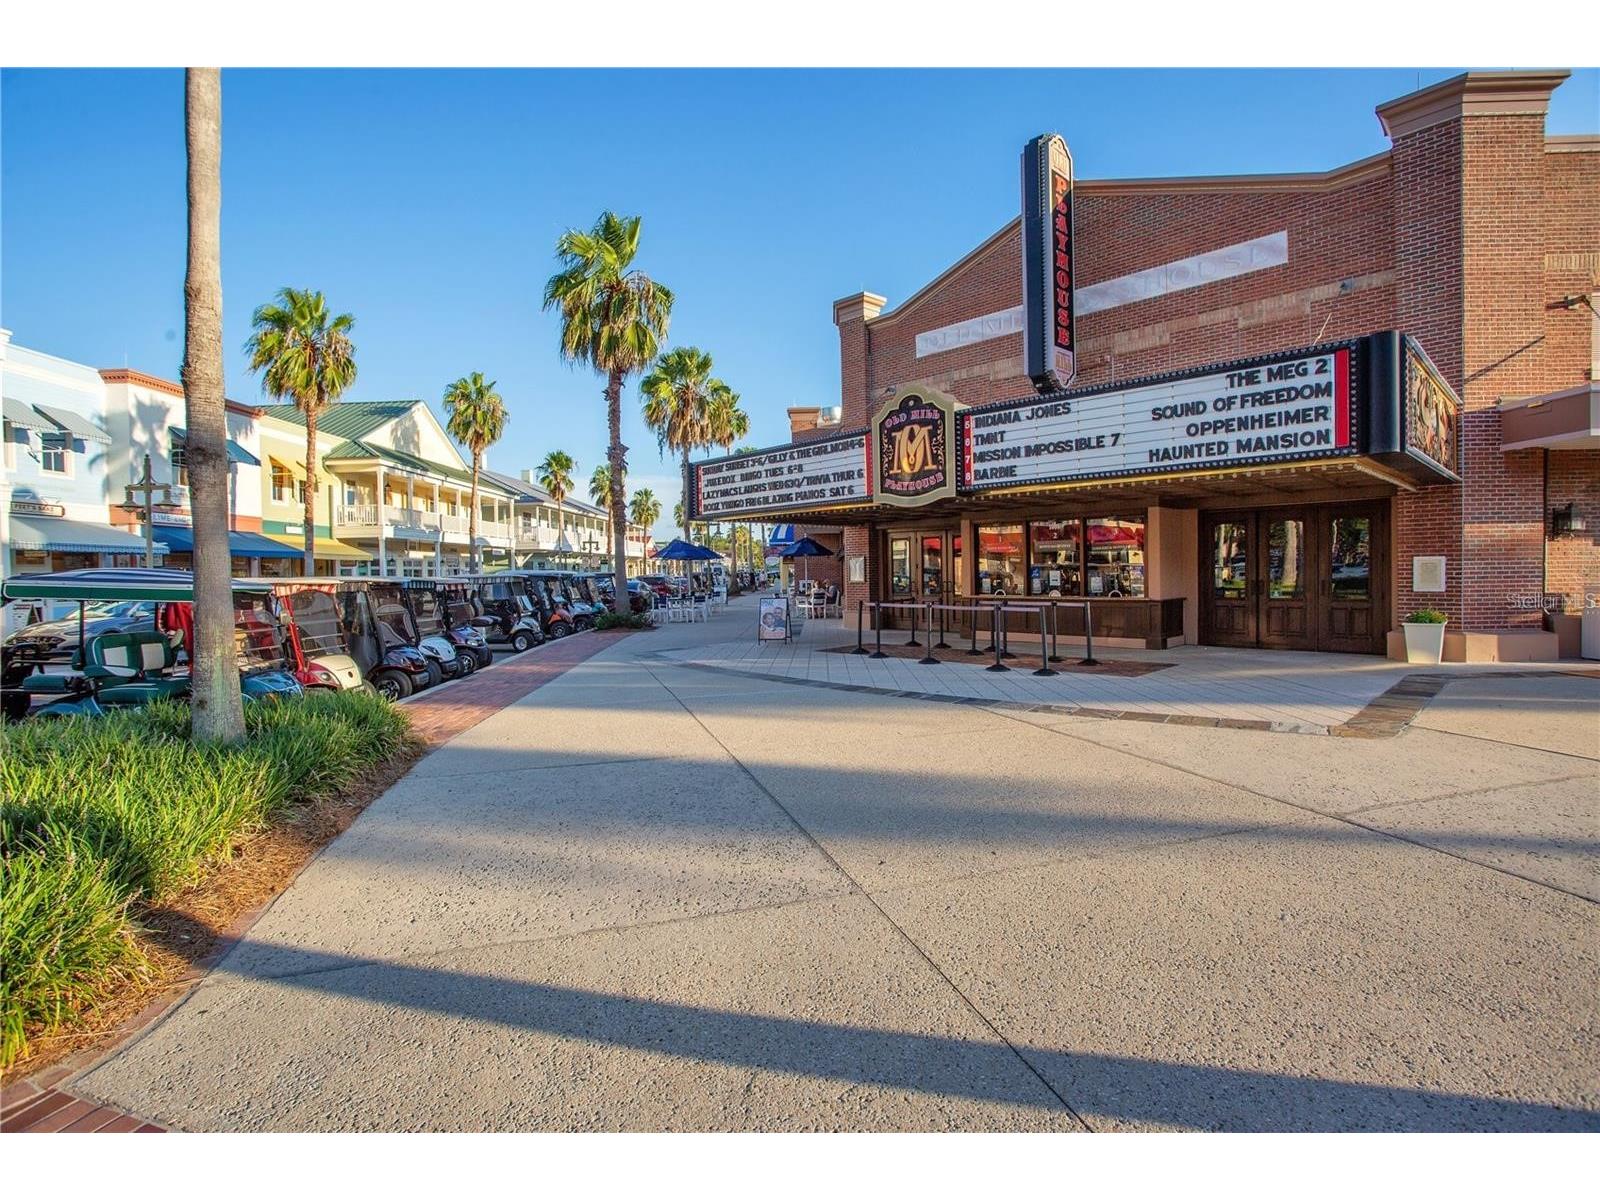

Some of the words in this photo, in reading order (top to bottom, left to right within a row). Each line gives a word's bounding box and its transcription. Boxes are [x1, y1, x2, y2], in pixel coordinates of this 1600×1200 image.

[1055, 174, 1070, 346] PLAYHOUSE
[1226, 369, 1261, 388] THE
[1266, 361, 1308, 382] MEG
[1314, 358, 1328, 375] 2
[1151, 400, 1208, 421] SOUND
[1212, 395, 1238, 412] OF
[1240, 381, 1332, 409] FREEDOM
[884, 412, 908, 428] OLD
[910, 409, 940, 420] MILL
[974, 411, 1021, 429] INDIANA
[1026, 402, 1071, 420] JONES
[1185, 405, 1329, 437] OPPENHEIMER
[973, 430, 1006, 446] TMNT
[1148, 440, 1229, 463] HAUNTED
[1236, 428, 1330, 454] MANSION
[796, 447, 812, 459] THE
[973, 446, 1021, 464] MISSION
[1024, 435, 1106, 458] IMPOSSIBLE
[1110, 432, 1121, 447] 7
[764, 467, 784, 478] TUES
[831, 470, 855, 482] THUR
[884, 472, 945, 490] PLAYHOUSE
[974, 464, 1017, 481] BARBIE
[829, 486, 846, 497] SAT
